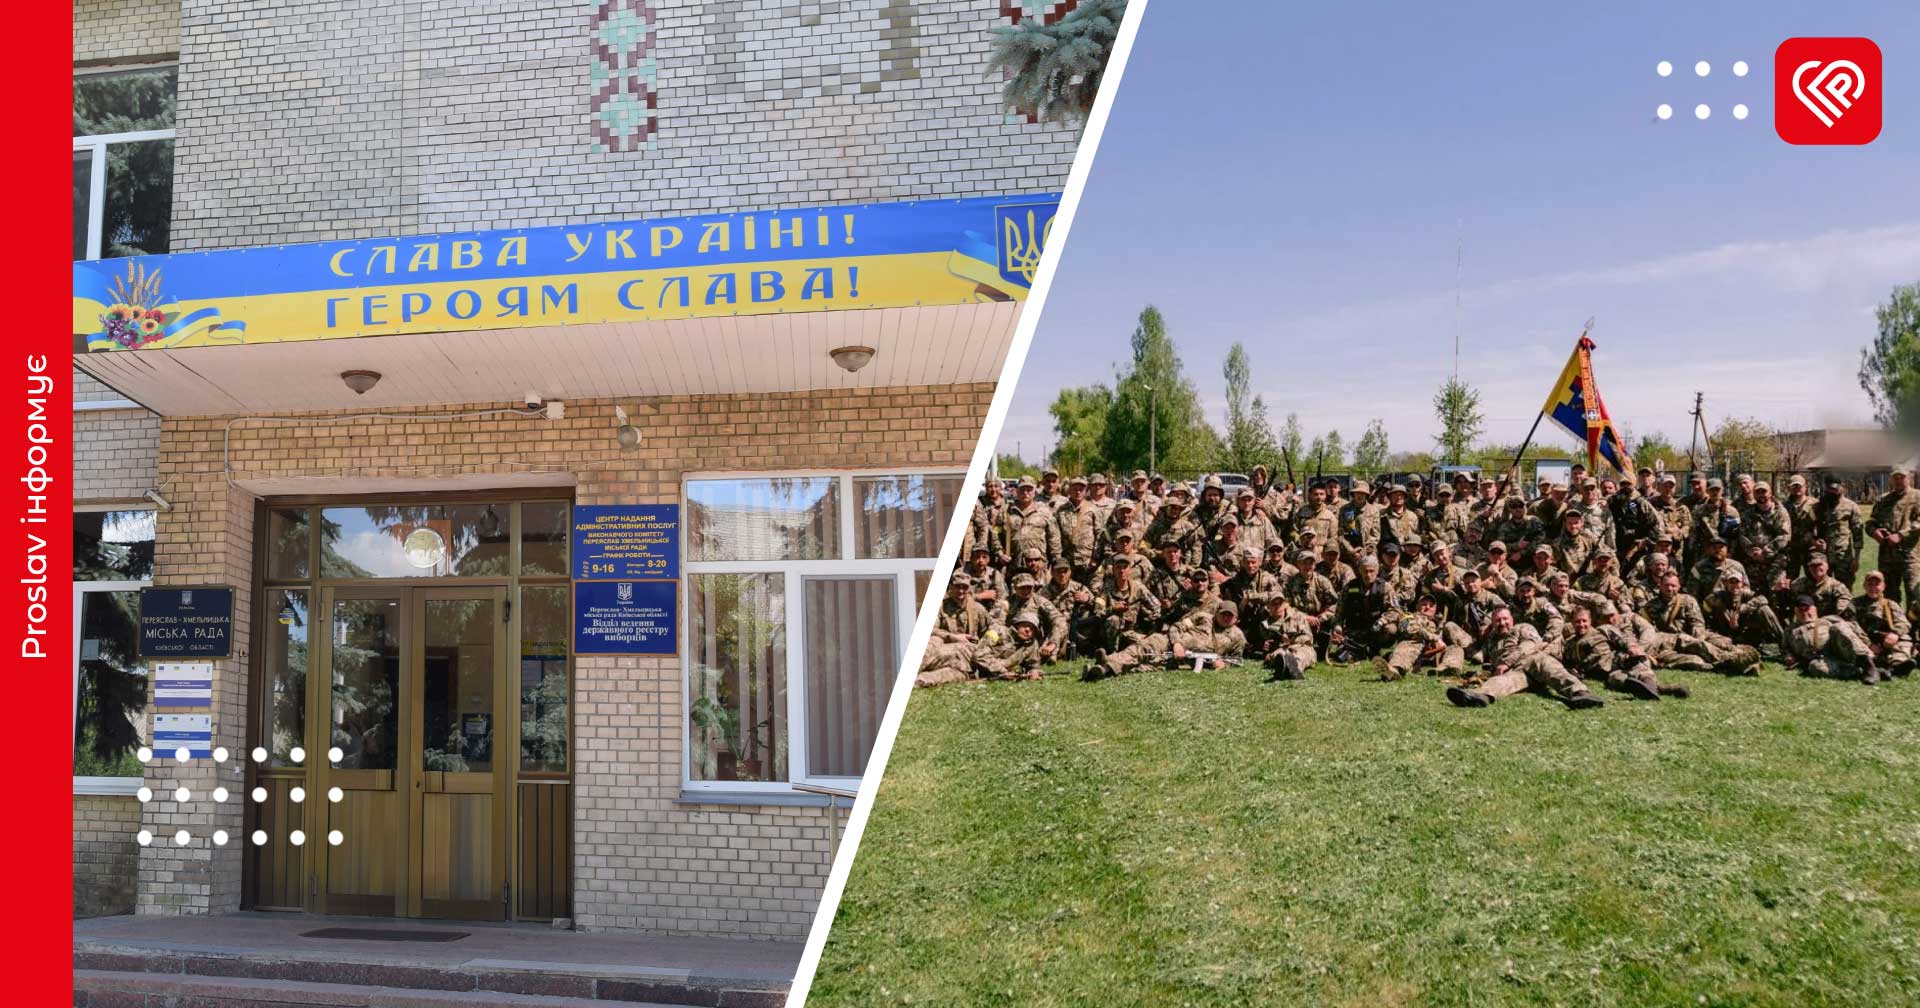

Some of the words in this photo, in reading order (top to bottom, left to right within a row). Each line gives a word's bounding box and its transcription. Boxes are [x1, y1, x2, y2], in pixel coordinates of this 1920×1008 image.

[329, 229, 529, 278] СЛАВА
[564, 212, 857, 263] УКРАЇНІ!
[325, 281, 579, 329] ГЕРОЯМ
[616, 265, 861, 311] СЛАВА!
[592, 563, 615, 573] 9-16
[647, 559, 667, 568] 8-20
[592, 618, 619, 627] Відділ
[145, 628, 188, 639] МІСЬКА
[194, 627, 224, 639] РАДА
[582, 626, 634, 635] державного
[635, 626, 669, 636] реєстру
